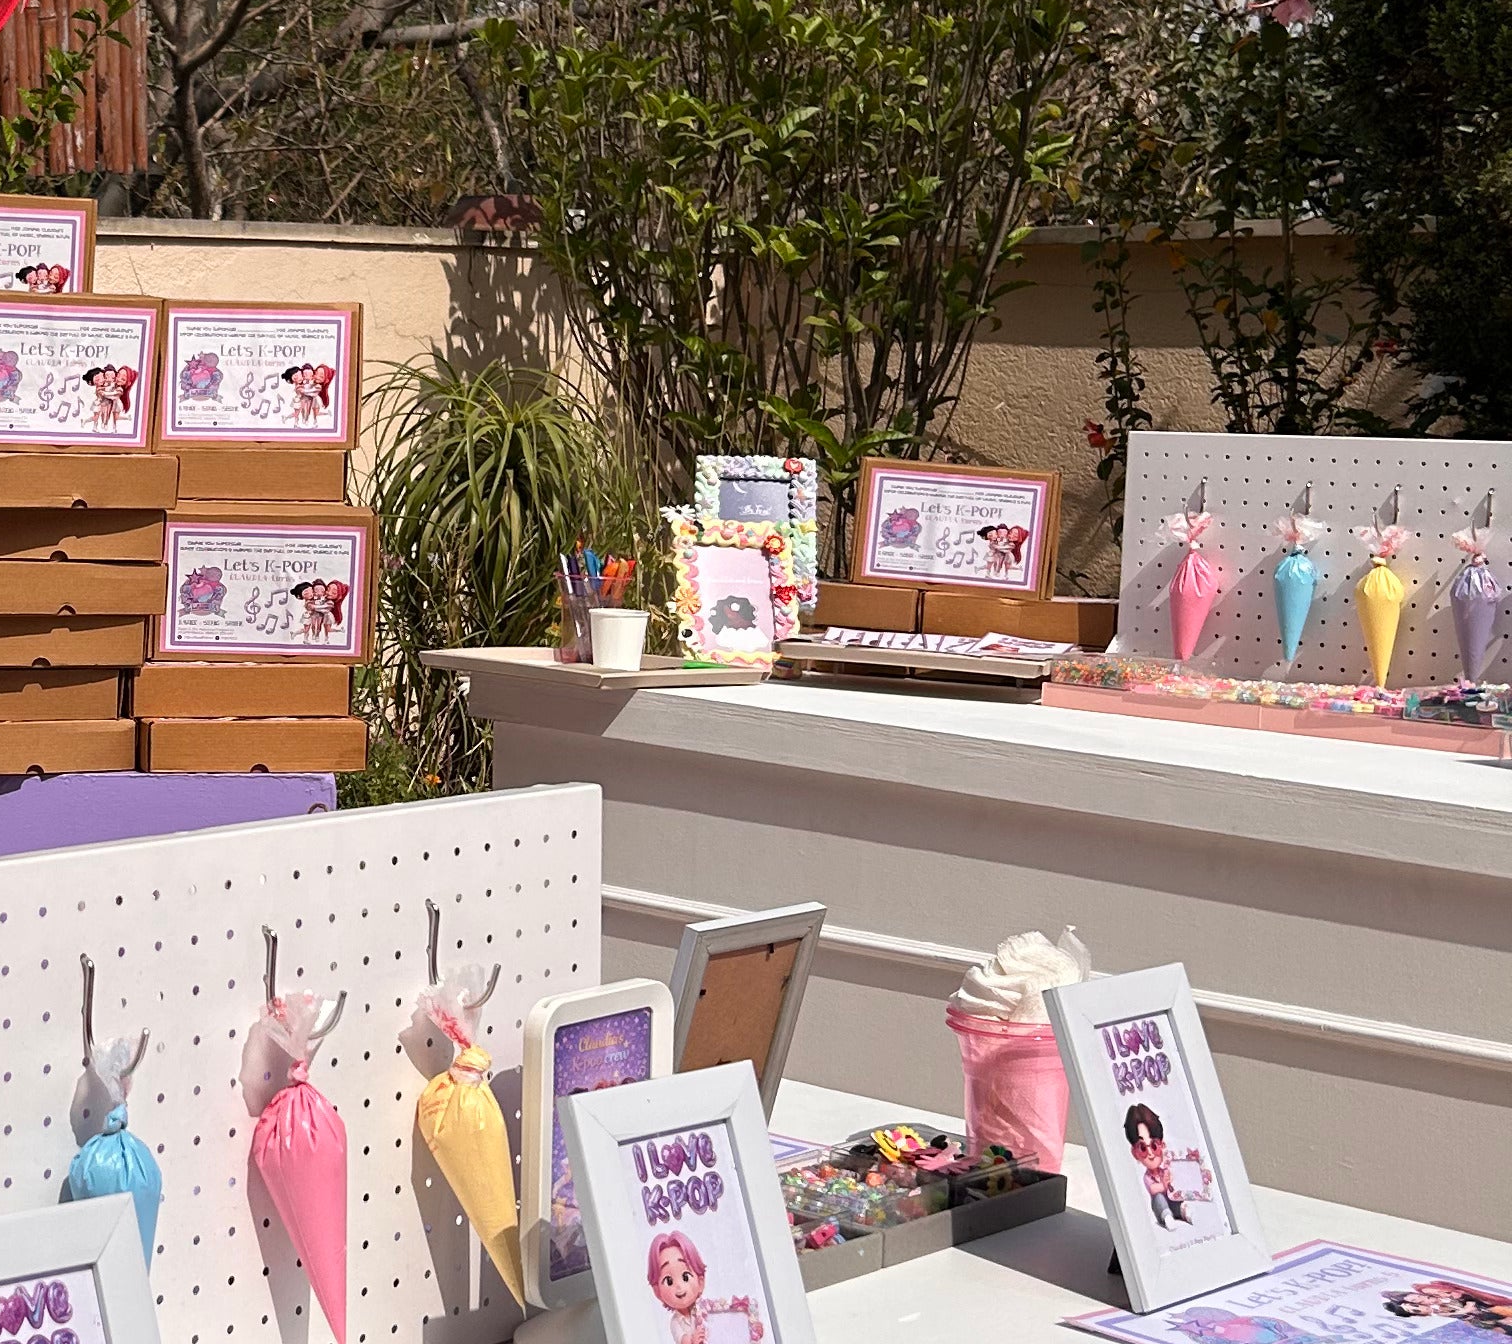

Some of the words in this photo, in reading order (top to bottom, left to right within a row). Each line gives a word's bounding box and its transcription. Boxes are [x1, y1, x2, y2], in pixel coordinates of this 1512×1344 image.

[20, 341, 55, 356] Let's
[220, 343, 254, 358] Let's
[920, 501, 952, 515] Let's
[223, 558, 260, 573] Let's
[264, 559, 318, 574] K-POP!
[1102, 1028, 1116, 1060] I
[632, 1143, 648, 1183] I
[1225, 1282, 1299, 1309] Let's
